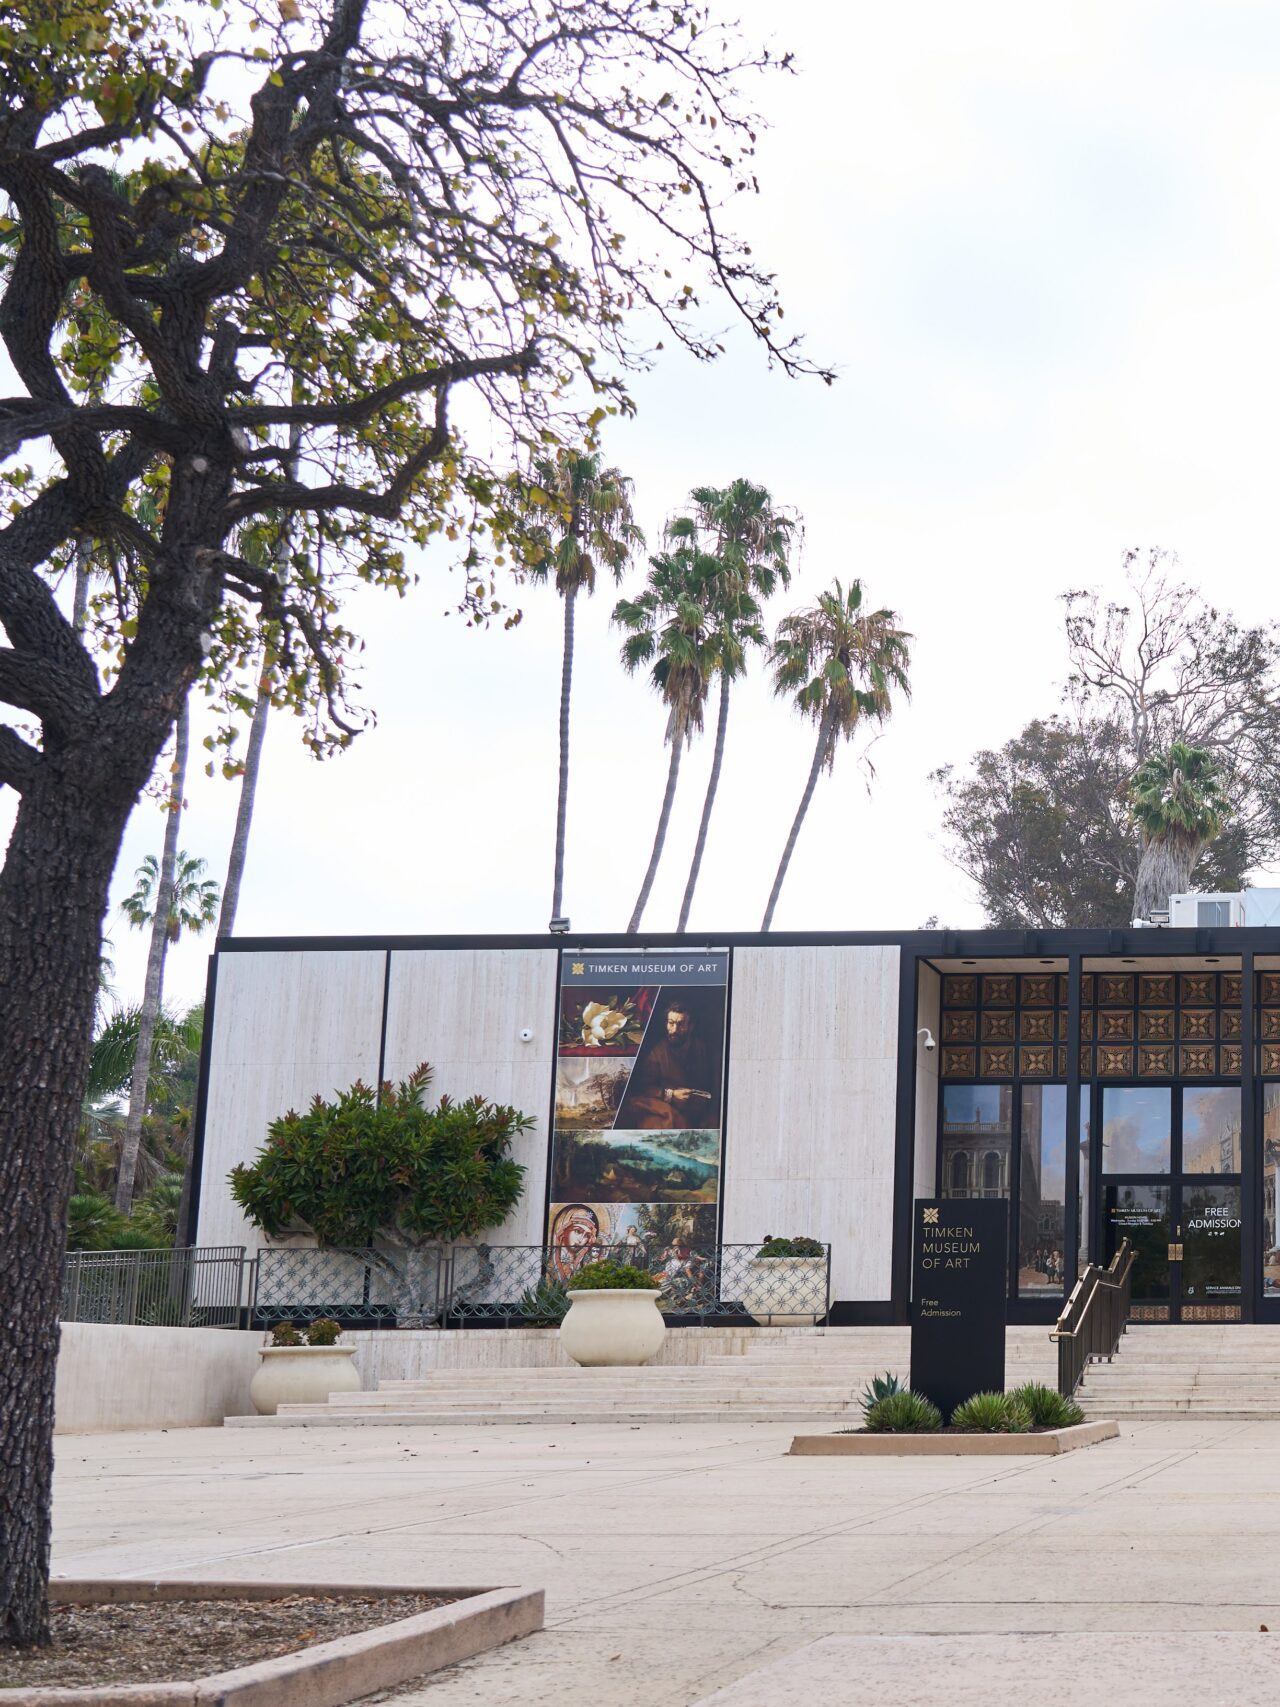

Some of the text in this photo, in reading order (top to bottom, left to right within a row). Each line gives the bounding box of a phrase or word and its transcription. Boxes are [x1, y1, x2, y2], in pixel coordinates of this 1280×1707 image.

[588, 964, 718, 973] TIMKEN MUSEUM OF ART
[1205, 1208, 1228, 1216] FREE
[923, 1227, 973, 1238] TIMKEN
[923, 1243, 980, 1254] MUSEUM
[922, 1258, 971, 1269] OF ART
